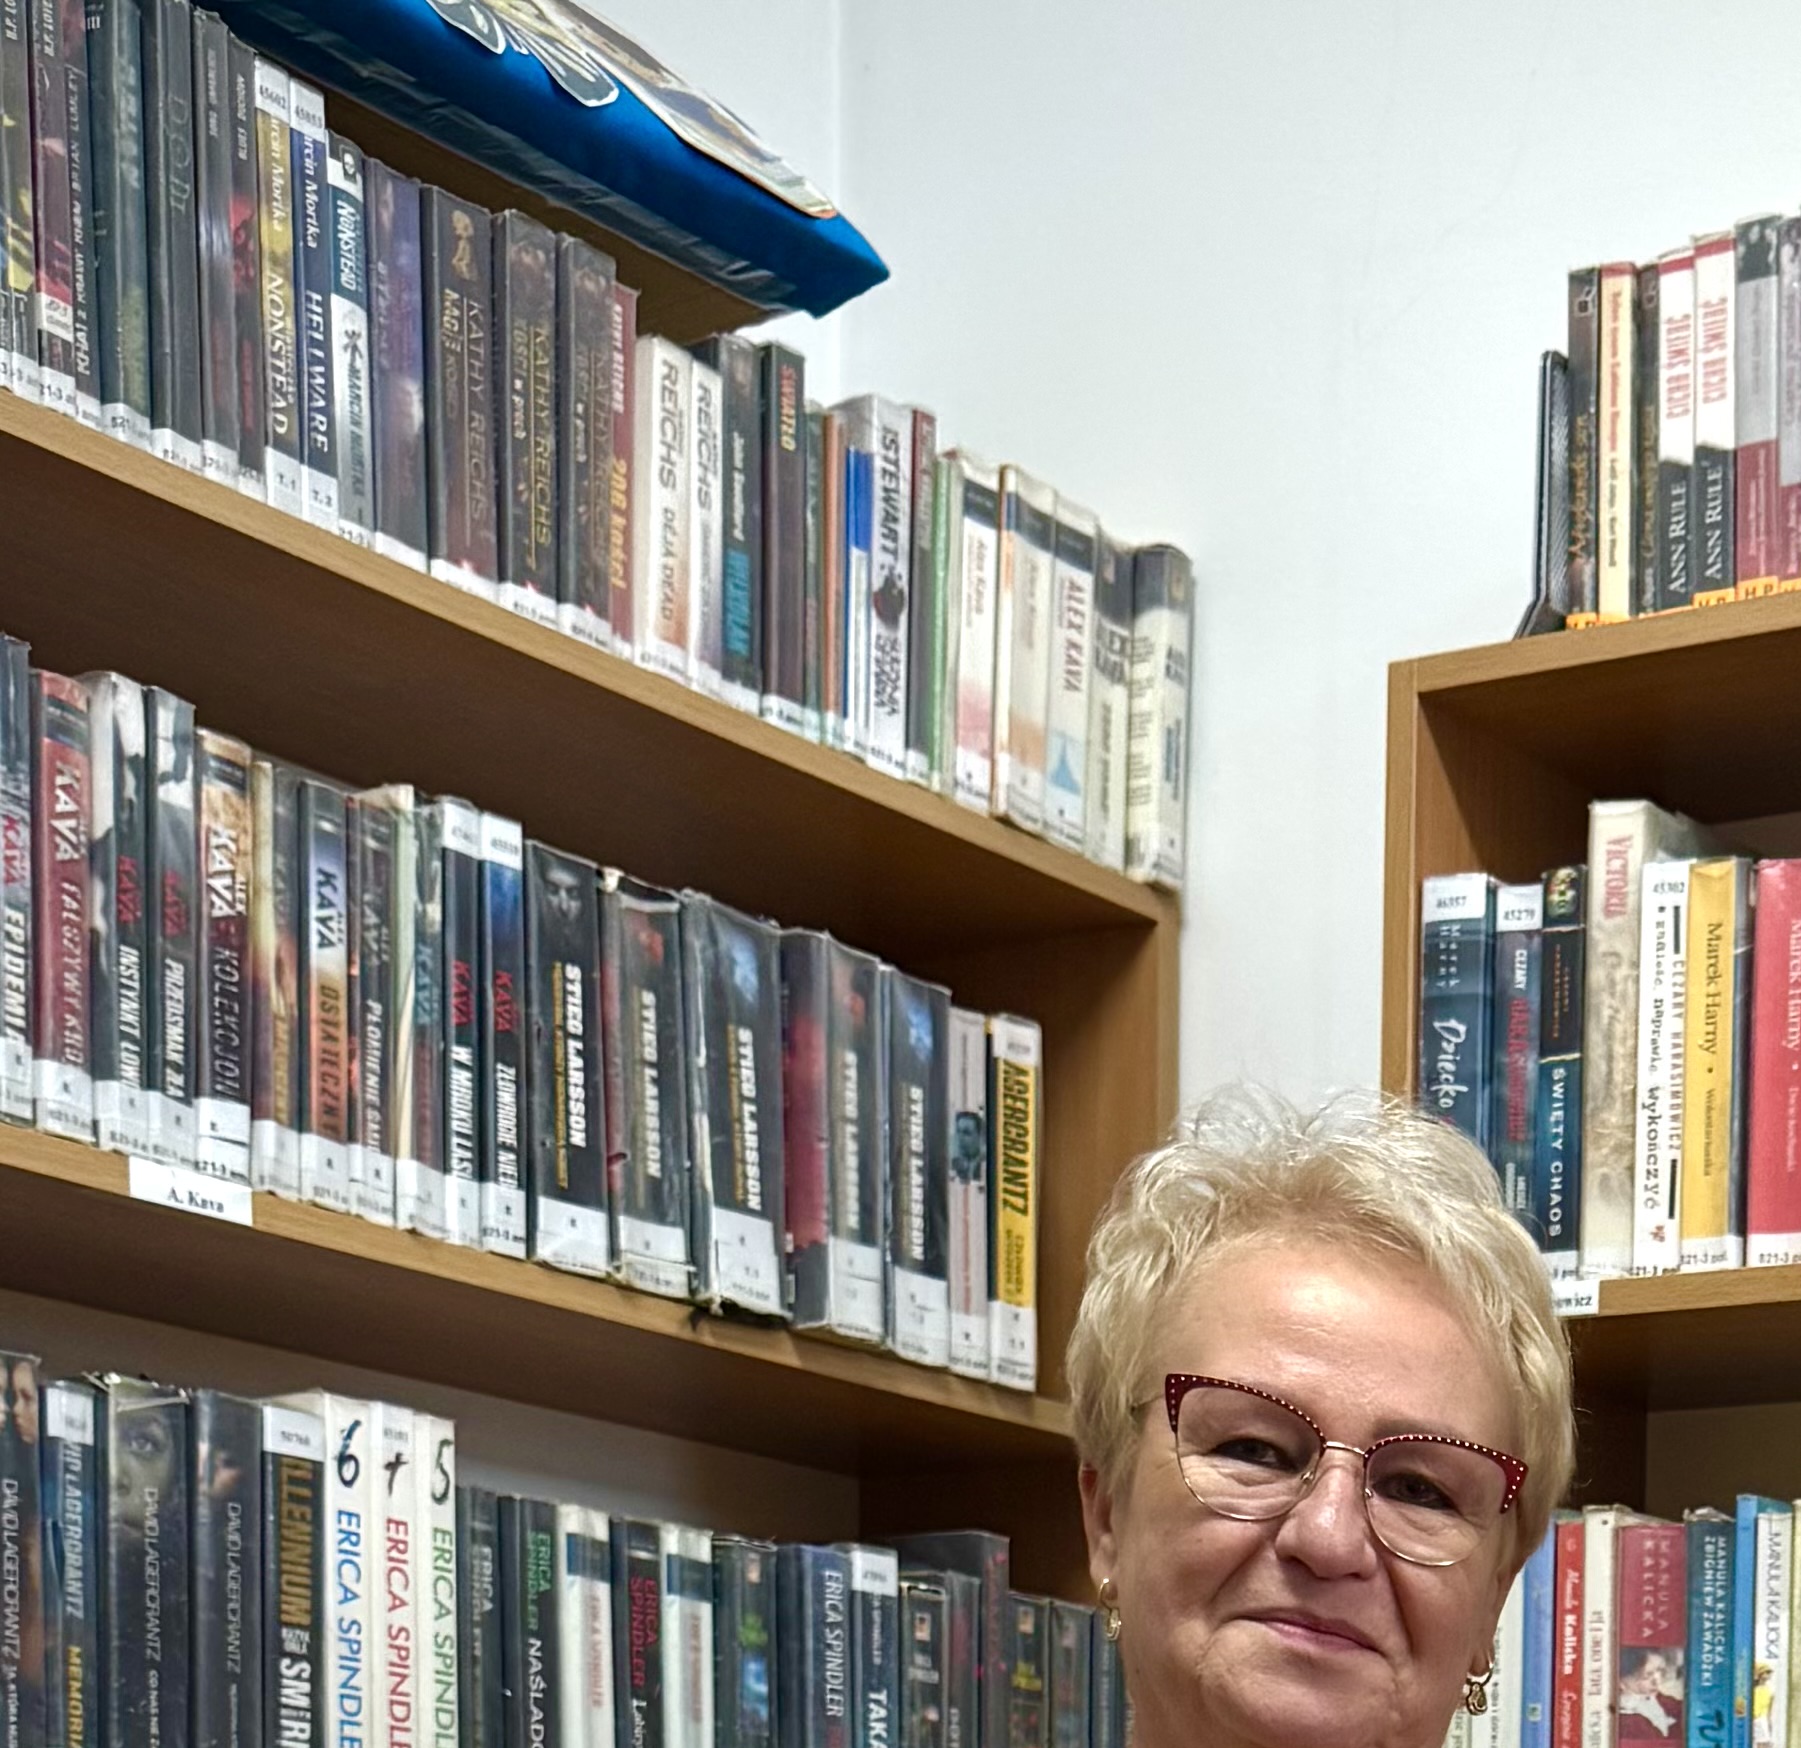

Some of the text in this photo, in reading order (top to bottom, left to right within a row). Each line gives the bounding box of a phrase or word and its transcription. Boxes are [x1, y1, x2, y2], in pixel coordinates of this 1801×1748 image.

[267, 272, 291, 437] NONSTEAD
[304, 290, 328, 455] HELLWARE
[659, 358, 679, 491] REICHS
[564, 962, 588, 1150] STIEG LARSSON
[431, 1438, 454, 1505] 5
[337, 1509, 363, 1606] ERICA
[386, 1518, 412, 1615] ERICA
[432, 1526, 455, 1622] ERICA
